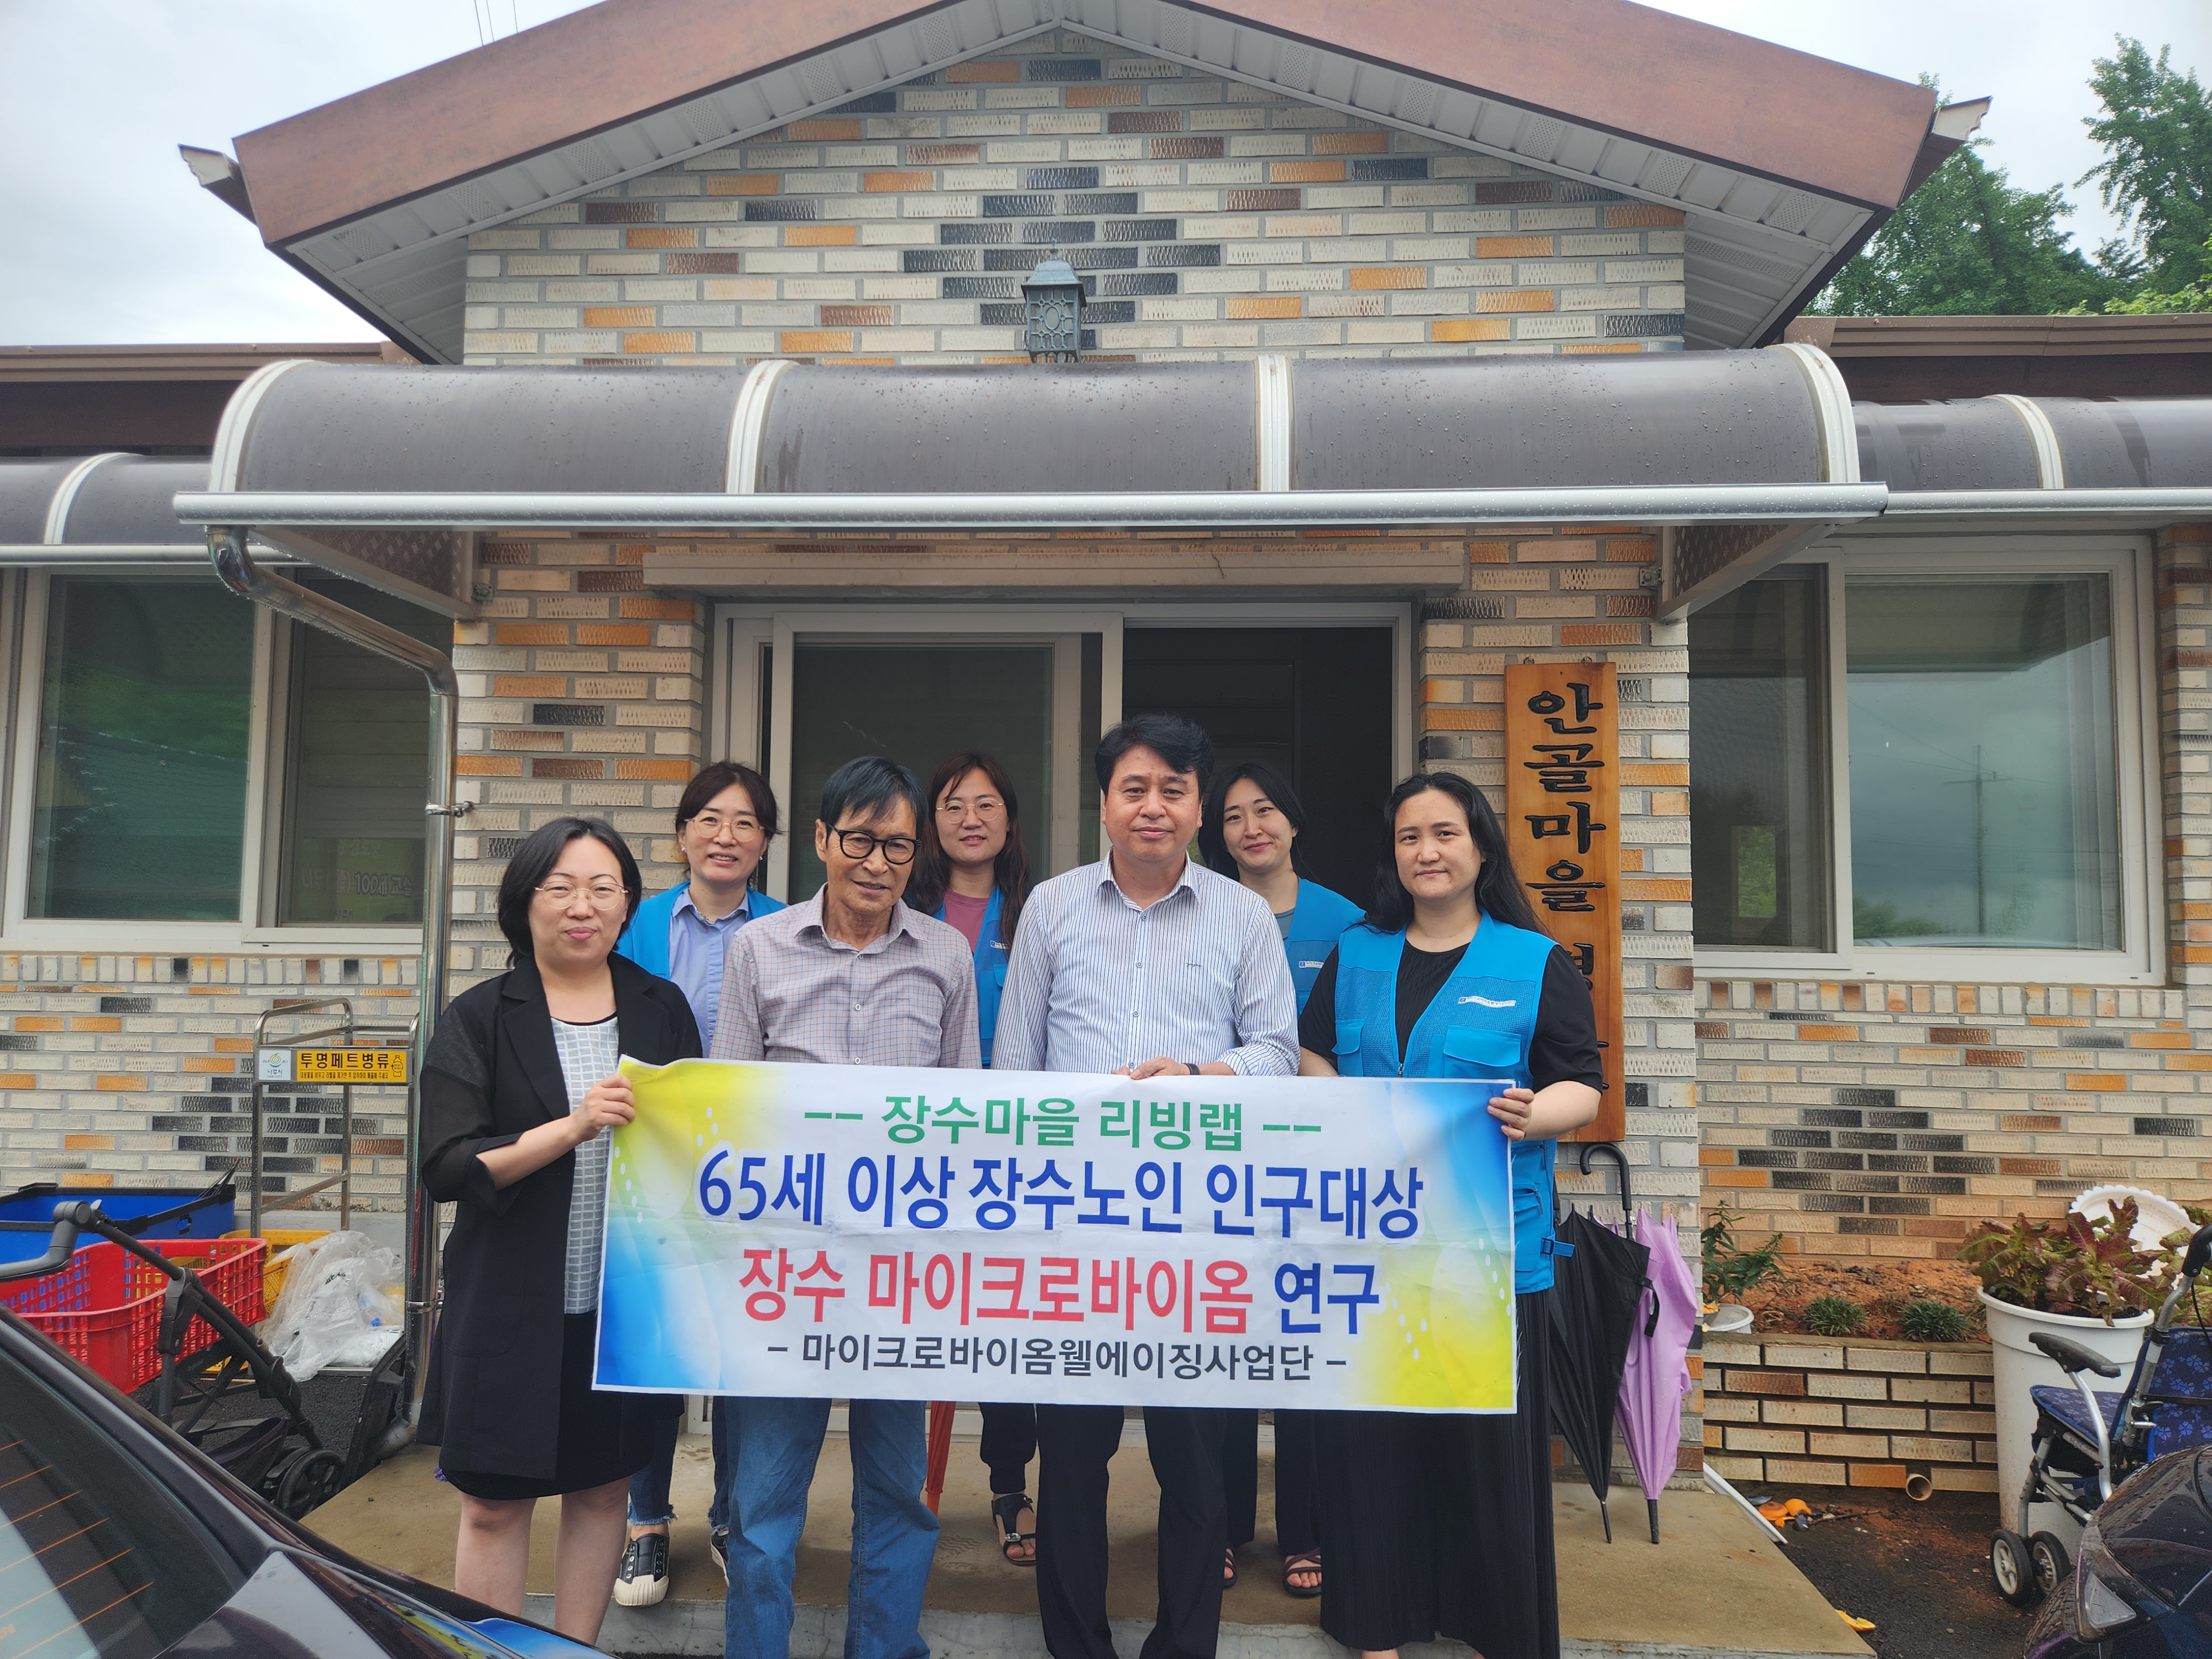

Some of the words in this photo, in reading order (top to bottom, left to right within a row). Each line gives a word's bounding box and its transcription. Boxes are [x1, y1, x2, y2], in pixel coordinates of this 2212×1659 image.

[1523, 681, 1607, 913] 안골마을
[355, 872, 388, 895] 100세
[300, 1053, 389, 1069] 투명페트병류
[881, 1096, 1079, 1146] 장수마을
[1100, 1100, 1243, 1152] 리빙랩
[699, 1150, 826, 1226] 65세
[847, 1154, 956, 1229] 이상
[968, 1157, 1182, 1233] 장수노인
[1206, 1164, 1424, 1240] 인구대상
[739, 1248, 846, 1323] 장수
[868, 1251, 1253, 1334] 마이크로바이옴
[1274, 1262, 1380, 1335] 연구
[802, 1332, 1314, 1381] 마이크로바이옴웰에이징사업단
